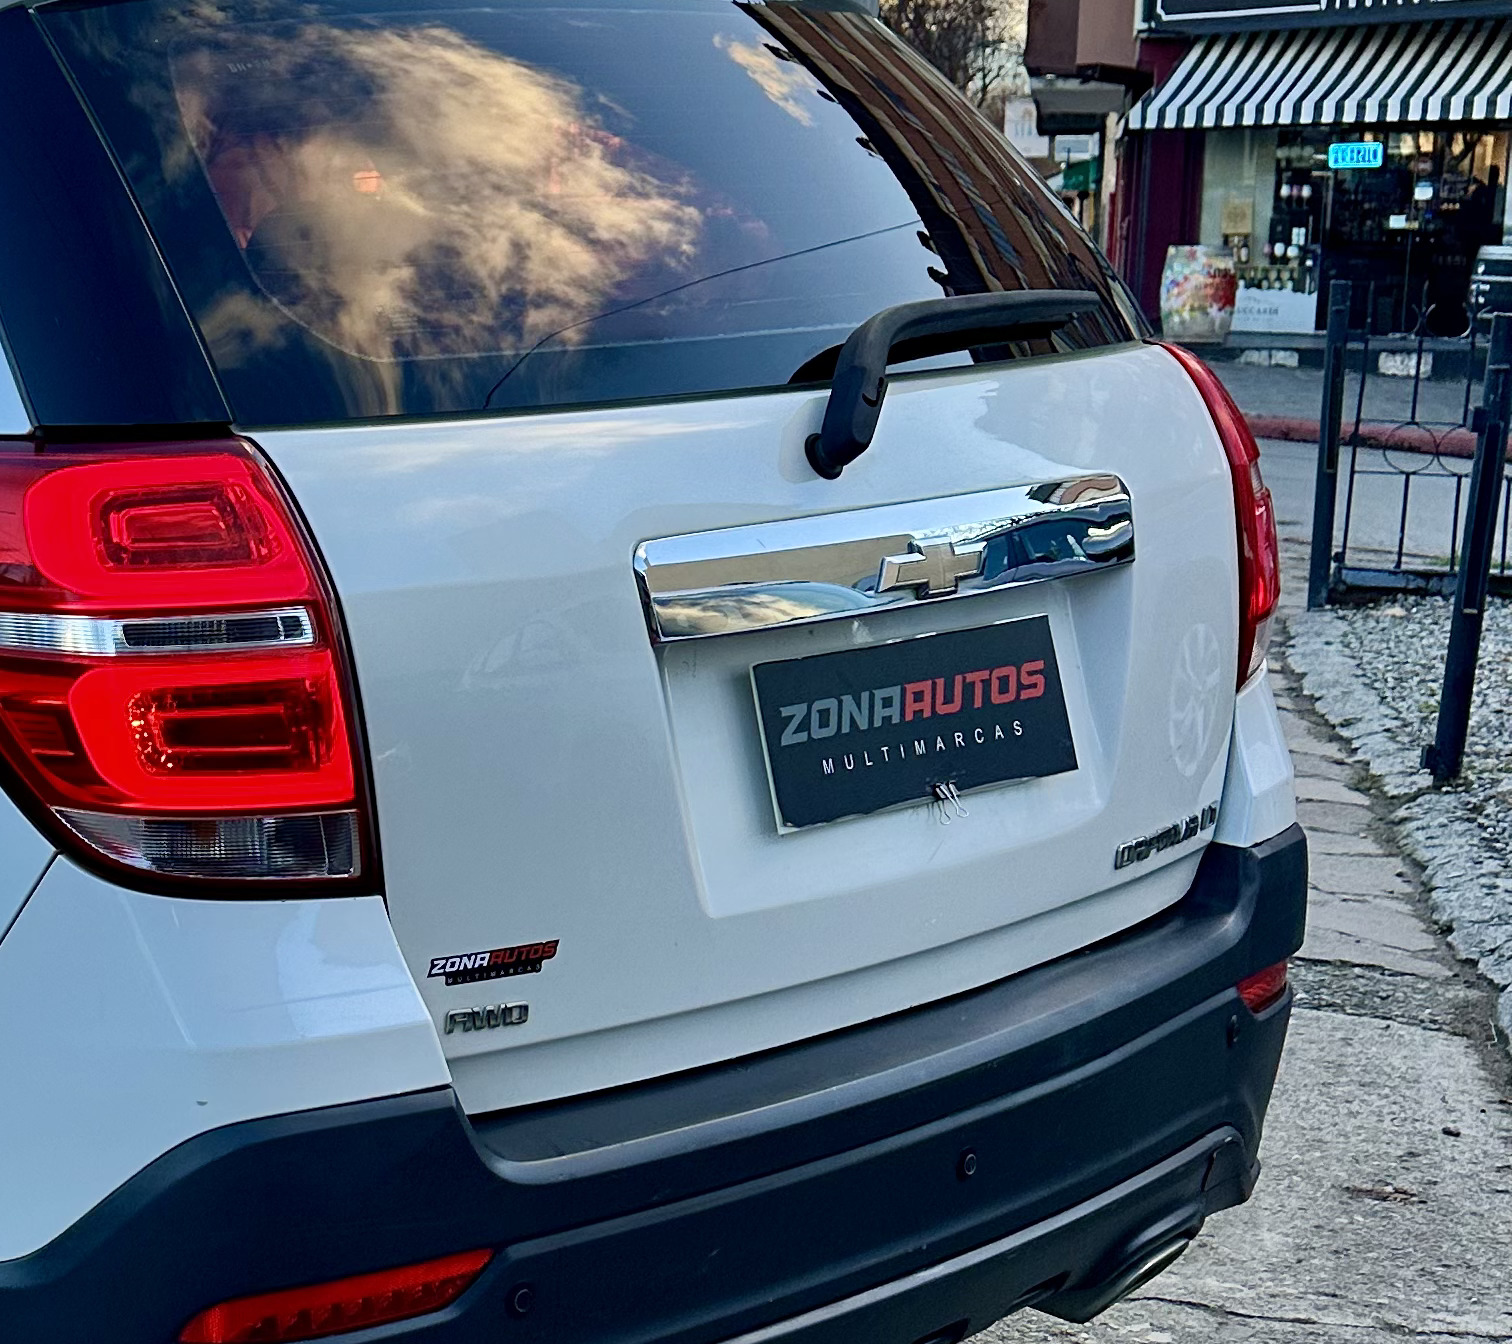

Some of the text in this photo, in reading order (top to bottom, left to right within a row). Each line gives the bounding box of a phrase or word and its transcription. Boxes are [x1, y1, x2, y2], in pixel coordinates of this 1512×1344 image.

[780, 660, 1046, 747] ZONAAUTOS
[822, 720, 1024, 775] MULTIMARCAS
[431, 942, 556, 975] ZONAAUTOS
[444, 1001, 529, 1035] AWD
